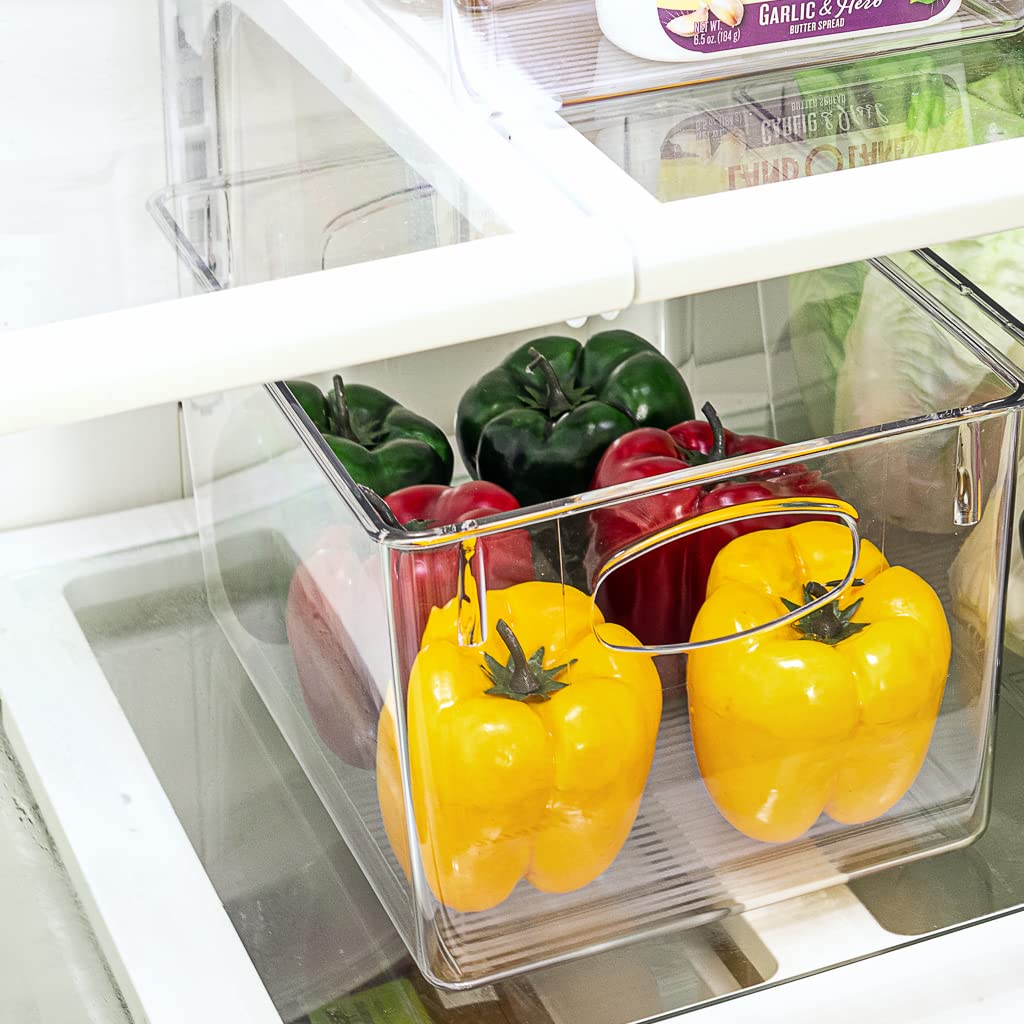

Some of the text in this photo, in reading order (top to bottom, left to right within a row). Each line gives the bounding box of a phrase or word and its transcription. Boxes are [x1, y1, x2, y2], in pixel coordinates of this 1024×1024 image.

[759, 2, 816, 26] GARLIC
[818, 1, 832, 17] &
[694, 19, 722, 33] NET WT.
[789, 18, 845, 35] BUTTER SPREAD
[693, 28, 741, 46] 6.5 oz. (184 g)
